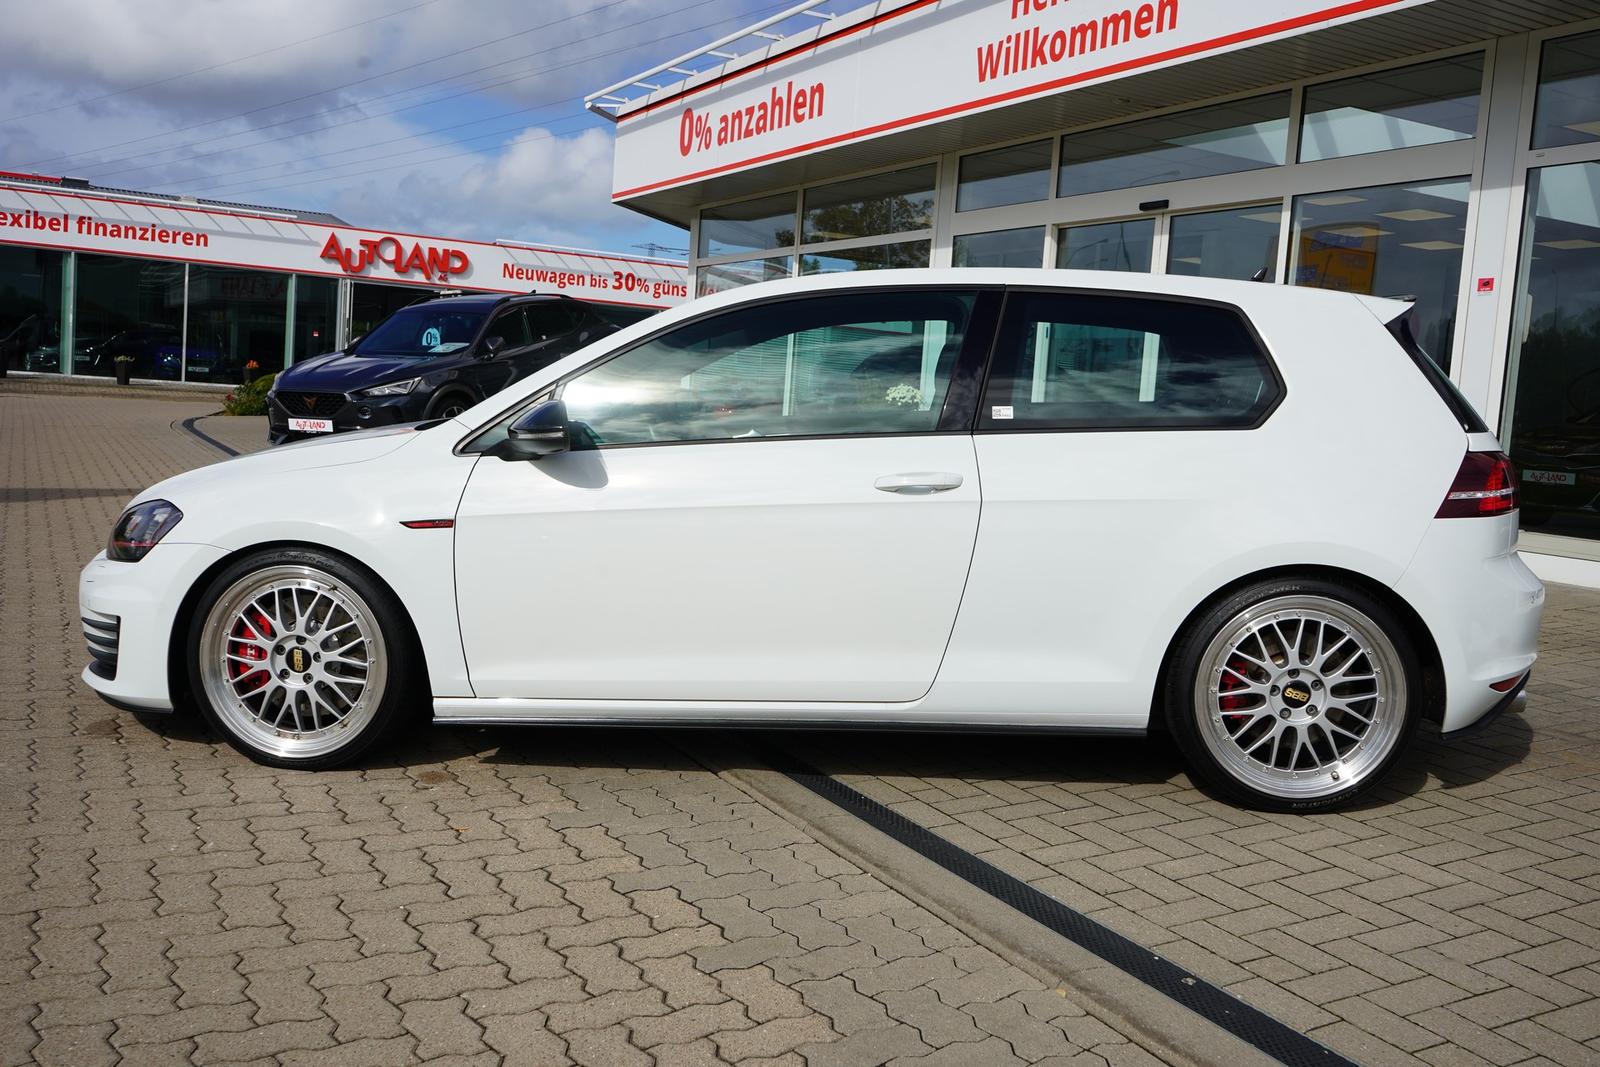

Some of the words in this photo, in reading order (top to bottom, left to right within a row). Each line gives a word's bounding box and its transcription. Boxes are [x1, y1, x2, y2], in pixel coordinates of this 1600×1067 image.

[977, 0, 1179, 84] Willkommen
[680, 108, 713, 157] 0%
[716, 81, 825, 146] anzahlen
[0, 210, 69, 233] exibel
[76, 215, 209, 248] finanzieren
[320, 231, 470, 280] AUTOLAND
[502, 263, 586, 289] Neuwagen
[589, 274, 609, 289] bis
[611, 270, 650, 294] 30%
[652, 279, 688, 299] güns
[293, 648, 304, 672] BBS
[1284, 687, 1308, 701] BBS
